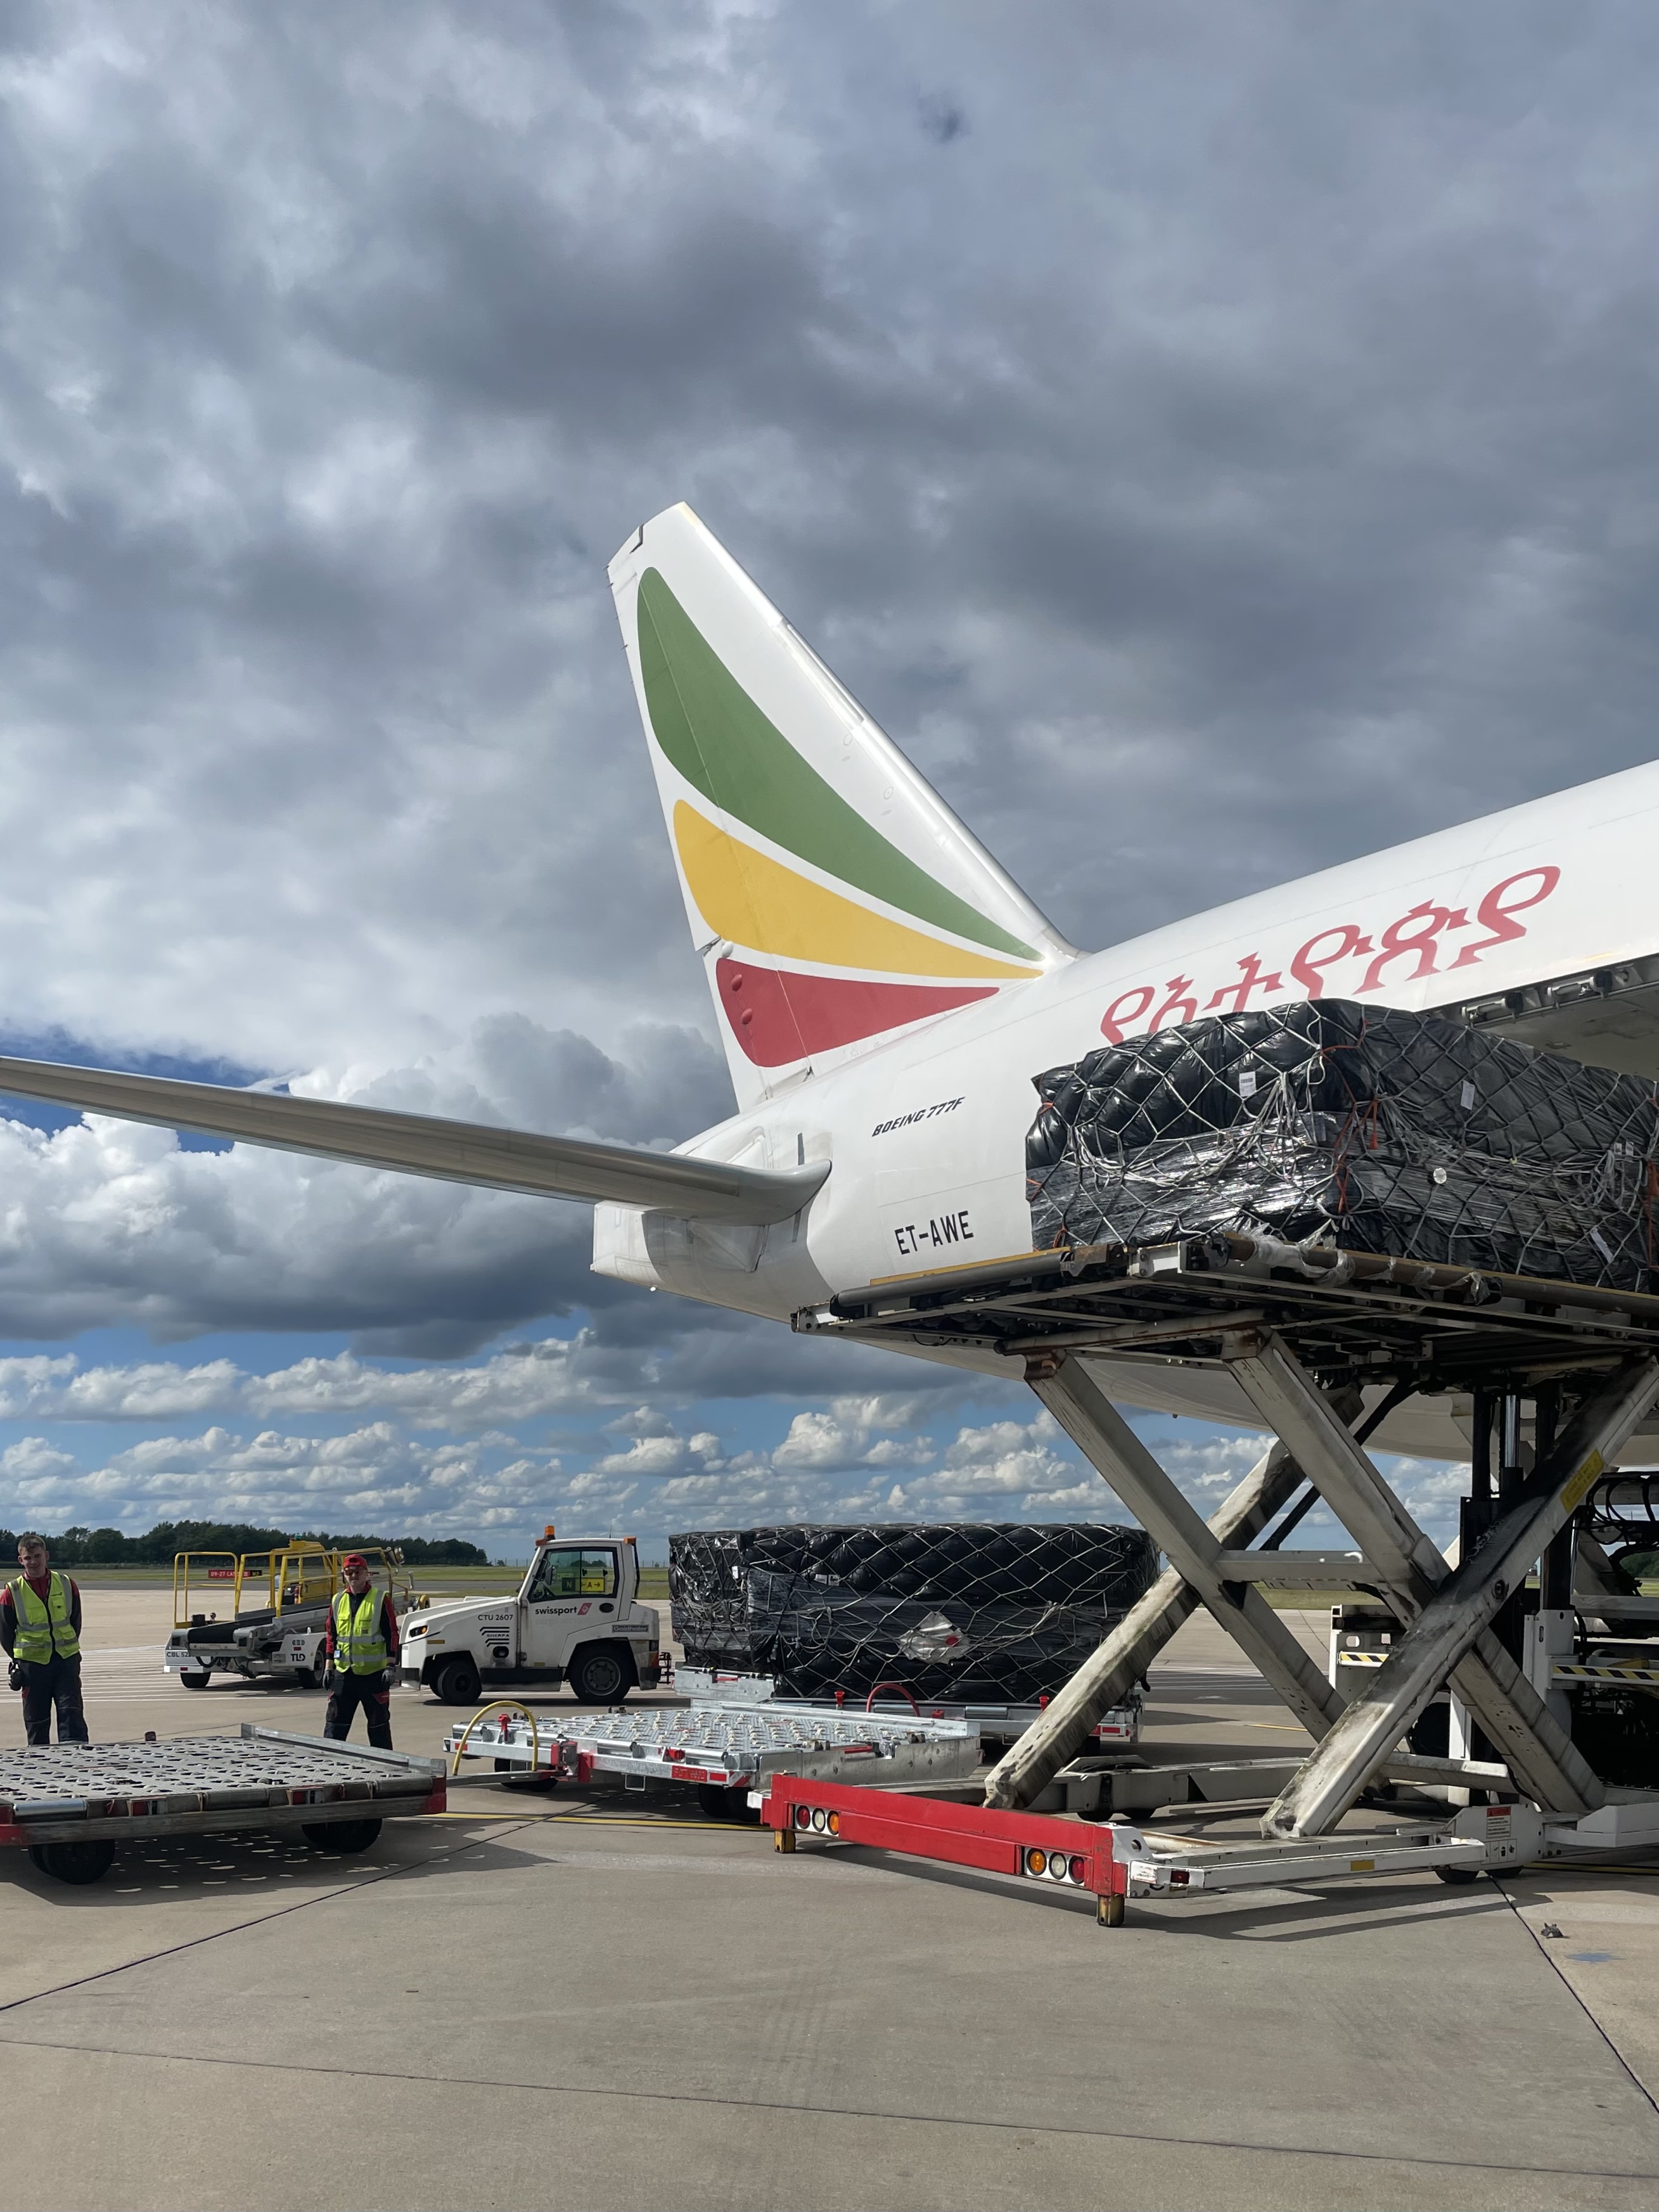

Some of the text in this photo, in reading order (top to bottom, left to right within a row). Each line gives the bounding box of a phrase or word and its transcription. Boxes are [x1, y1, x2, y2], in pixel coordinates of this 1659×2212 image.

[871, 1096, 966, 1137] BOEING 777F
[894, 1210, 974, 1255] ET-AWE
[587, 1581, 593, 1589] A
[535, 1606, 577, 1616] swissport
[290, 1653, 305, 1662] TLD
